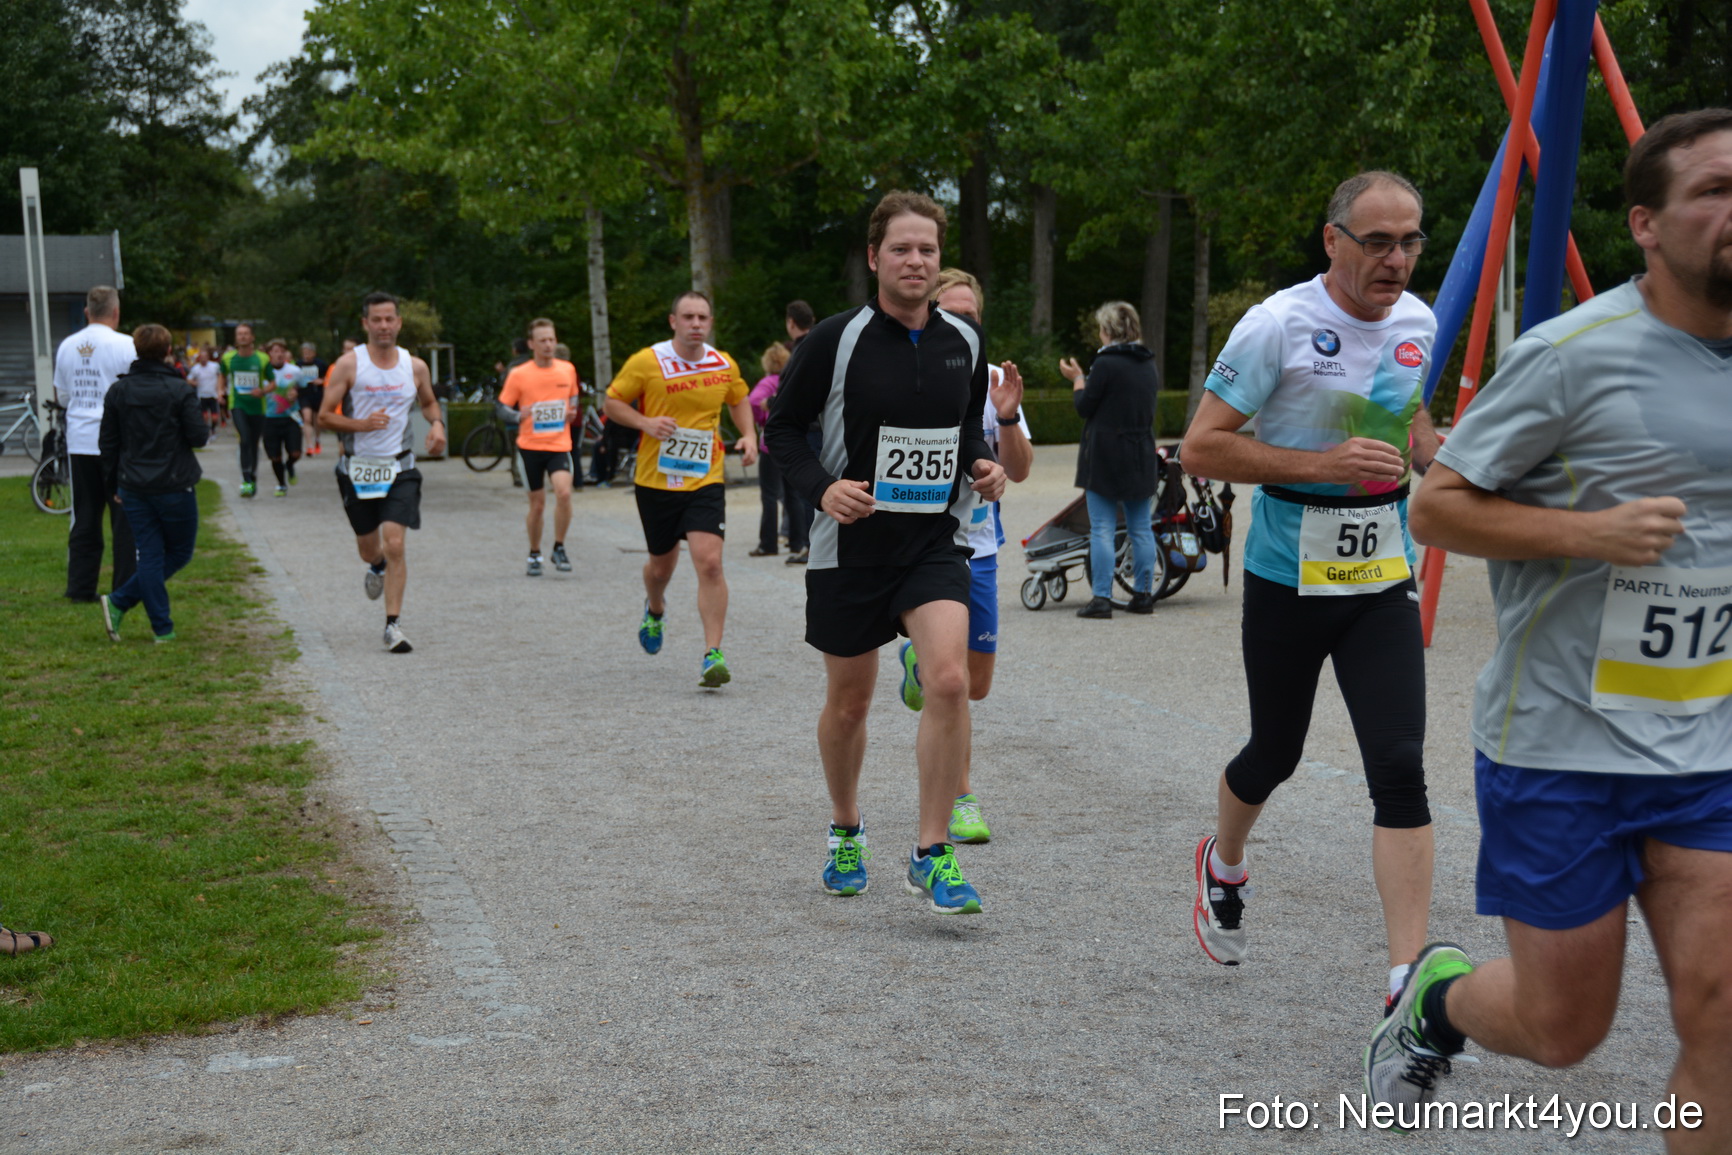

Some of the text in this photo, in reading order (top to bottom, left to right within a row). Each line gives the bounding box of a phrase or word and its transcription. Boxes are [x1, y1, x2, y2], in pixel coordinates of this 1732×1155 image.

[1313, 361, 1345, 371] PARTL
[666, 380, 699, 395] MAX
[535, 408, 564, 422] 2587
[881, 434, 952, 446] PARTL Neumarkt
[665, 438, 709, 460] 2775
[886, 448, 955, 481] 2355
[354, 466, 392, 482] 2800
[891, 487, 947, 501] Sebastian
[1306, 504, 1389, 520] PARTL Neumarkt
[1336, 521, 1379, 559] 56
[1326, 564, 1383, 582] Gerhard
[1612, 578, 1674, 598] PARTL
[1639, 602, 1732, 660] 512
